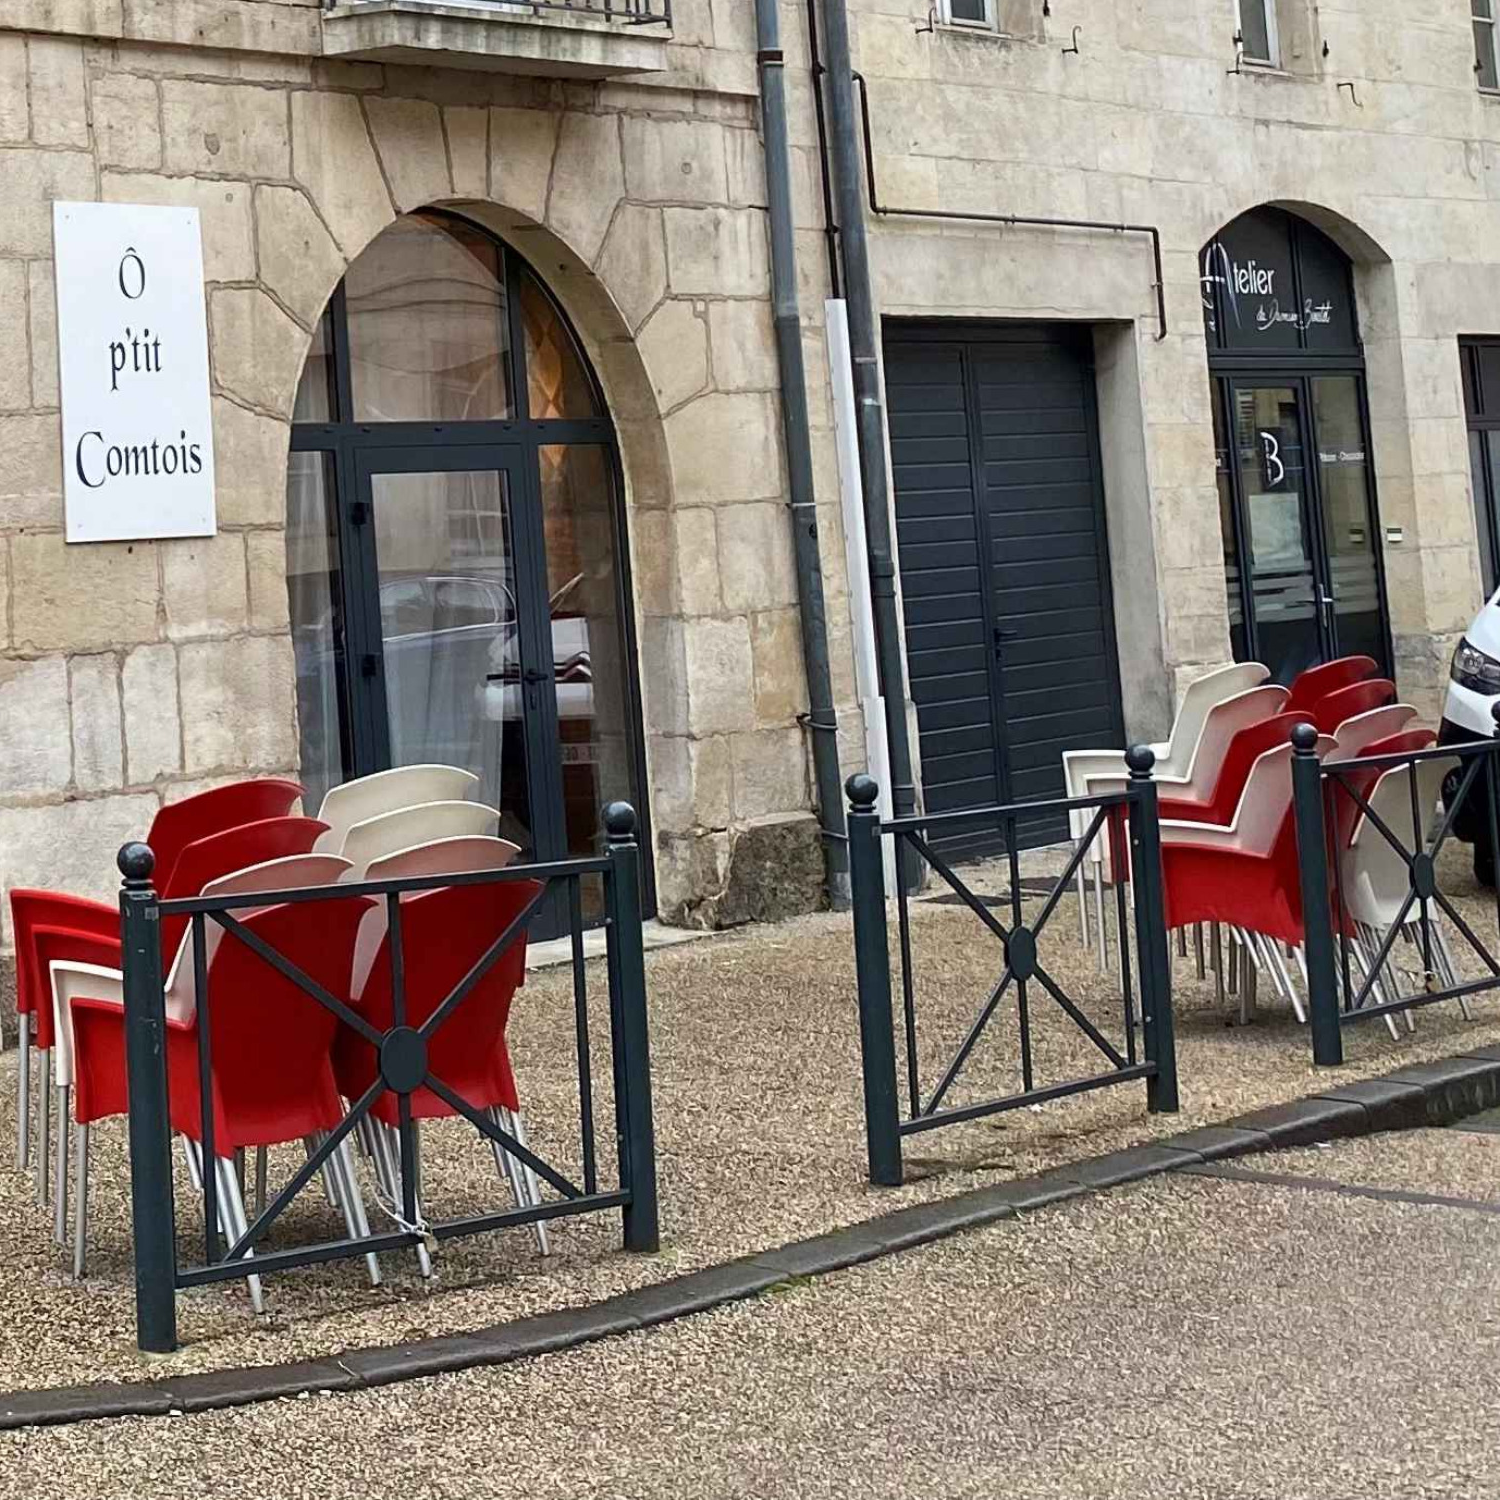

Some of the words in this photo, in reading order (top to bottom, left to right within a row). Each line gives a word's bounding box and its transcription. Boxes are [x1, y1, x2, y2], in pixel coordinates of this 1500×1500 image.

[118, 246, 146, 299] Ô
[1200, 243, 1275, 329] Atelier
[108, 327, 162, 391] p'tit
[75, 430, 202, 488] Comtois
